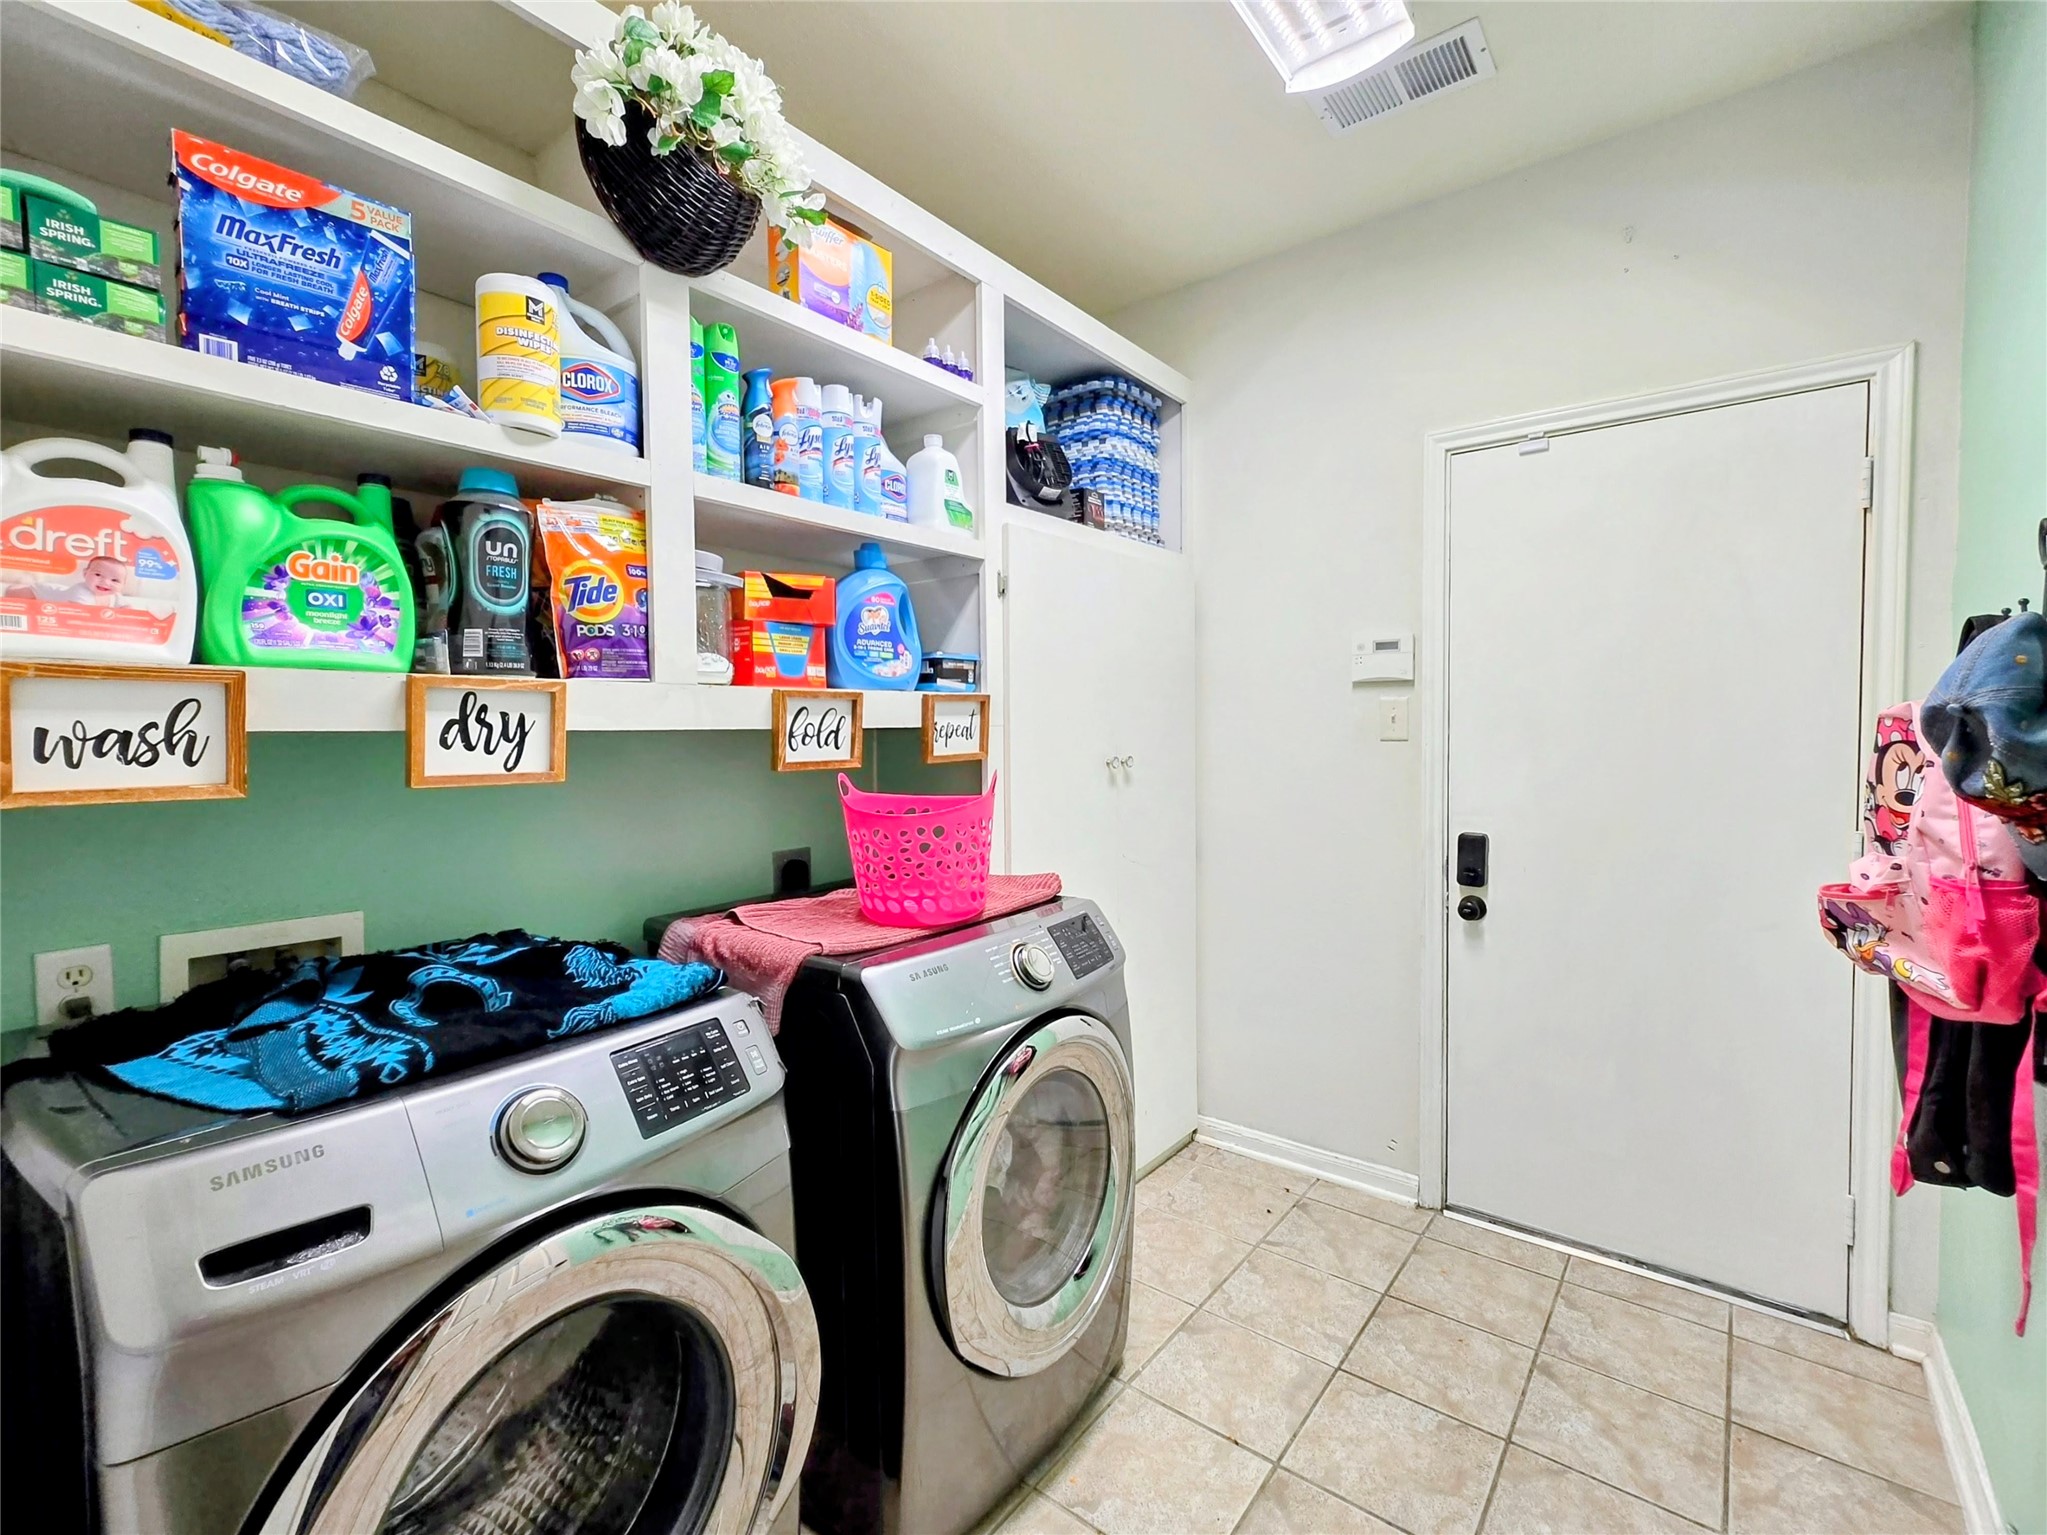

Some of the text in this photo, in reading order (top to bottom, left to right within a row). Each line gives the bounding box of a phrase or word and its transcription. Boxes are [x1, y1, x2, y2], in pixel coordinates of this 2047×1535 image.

[190, 153, 303, 203] Colgate
[351, 200, 404, 226] 5 VALUE
[45, 217, 85, 236] IRISH
[371, 216, 400, 233] PACK
[39, 226, 92, 248] SPRING
[215, 213, 342, 270] MaxFresh
[226, 255, 250, 269] 10X
[251, 266, 269, 276] FOR
[270, 271, 300, 285] FRESH
[52, 277, 92, 296] IRISH
[46, 287, 98, 308] SPRING
[340, 286, 369, 336] Colgate
[517, 336, 552, 356] WIPES
[562, 371, 613, 394] CLOROX
[560, 404, 599, 414] RFORMANCE
[799, 428, 822, 449] Lyso
[8, 517, 128, 563] dreft
[138, 558, 163, 570] 99%
[287, 551, 360, 586] Gain
[485, 564, 517, 580] FRESH
[307, 591, 344, 608] OXI
[563, 573, 619, 613] Tide
[305, 610, 349, 621] moonlight
[312, 617, 342, 626] breeze
[576, 623, 616, 637] PODS
[856, 638, 893, 648] ADVANCED
[33, 697, 210, 770] wash
[438, 691, 536, 773] dry
[787, 705, 847, 752] fold
[933, 708, 978, 748] repeat
[209, 1143, 326, 1192] SAMSUNG
[248, 1275, 285, 1295] STEAM
